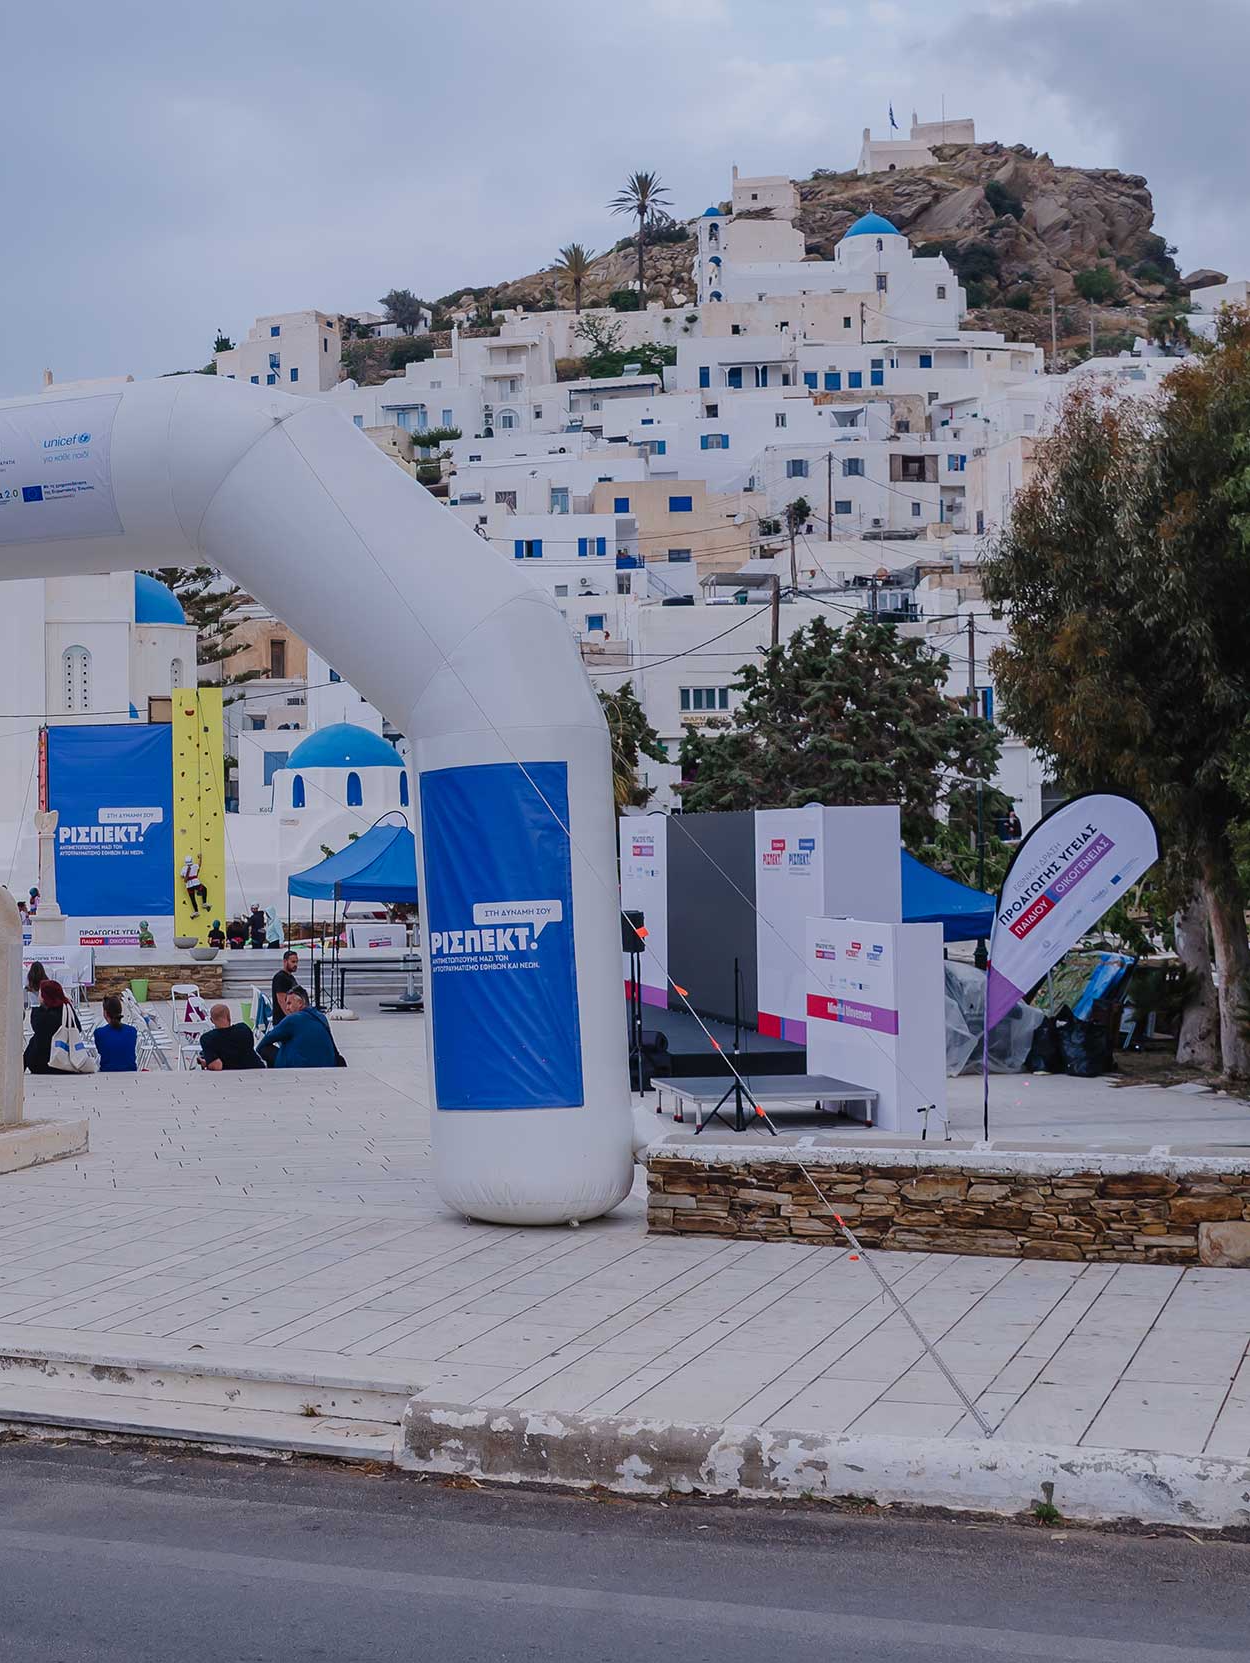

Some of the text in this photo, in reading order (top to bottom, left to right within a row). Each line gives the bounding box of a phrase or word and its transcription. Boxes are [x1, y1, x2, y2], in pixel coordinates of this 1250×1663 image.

[43, 433, 78, 449] unicef
[4, 489, 19, 499] 2.0
[998, 823, 1098, 926] ΠΡΟΑΓΩΓΗΣ ΥΓΕΙΑΣ
[1015, 899, 1048, 935] ΠΑΙΔΙΟΥ
[1055, 838, 1110, 893] ΟΙΚΟΓΕΝΕΙΑΣ
[484, 907, 552, 918] ΣΤΗ ΔΥΝΑΜΗ ΣΟΥ
[479, 954, 495, 962] ΜΑΖΙ
[495, 954, 509, 962] ΤΟΝ
[507, 962, 519, 970] ΚΑΙ
